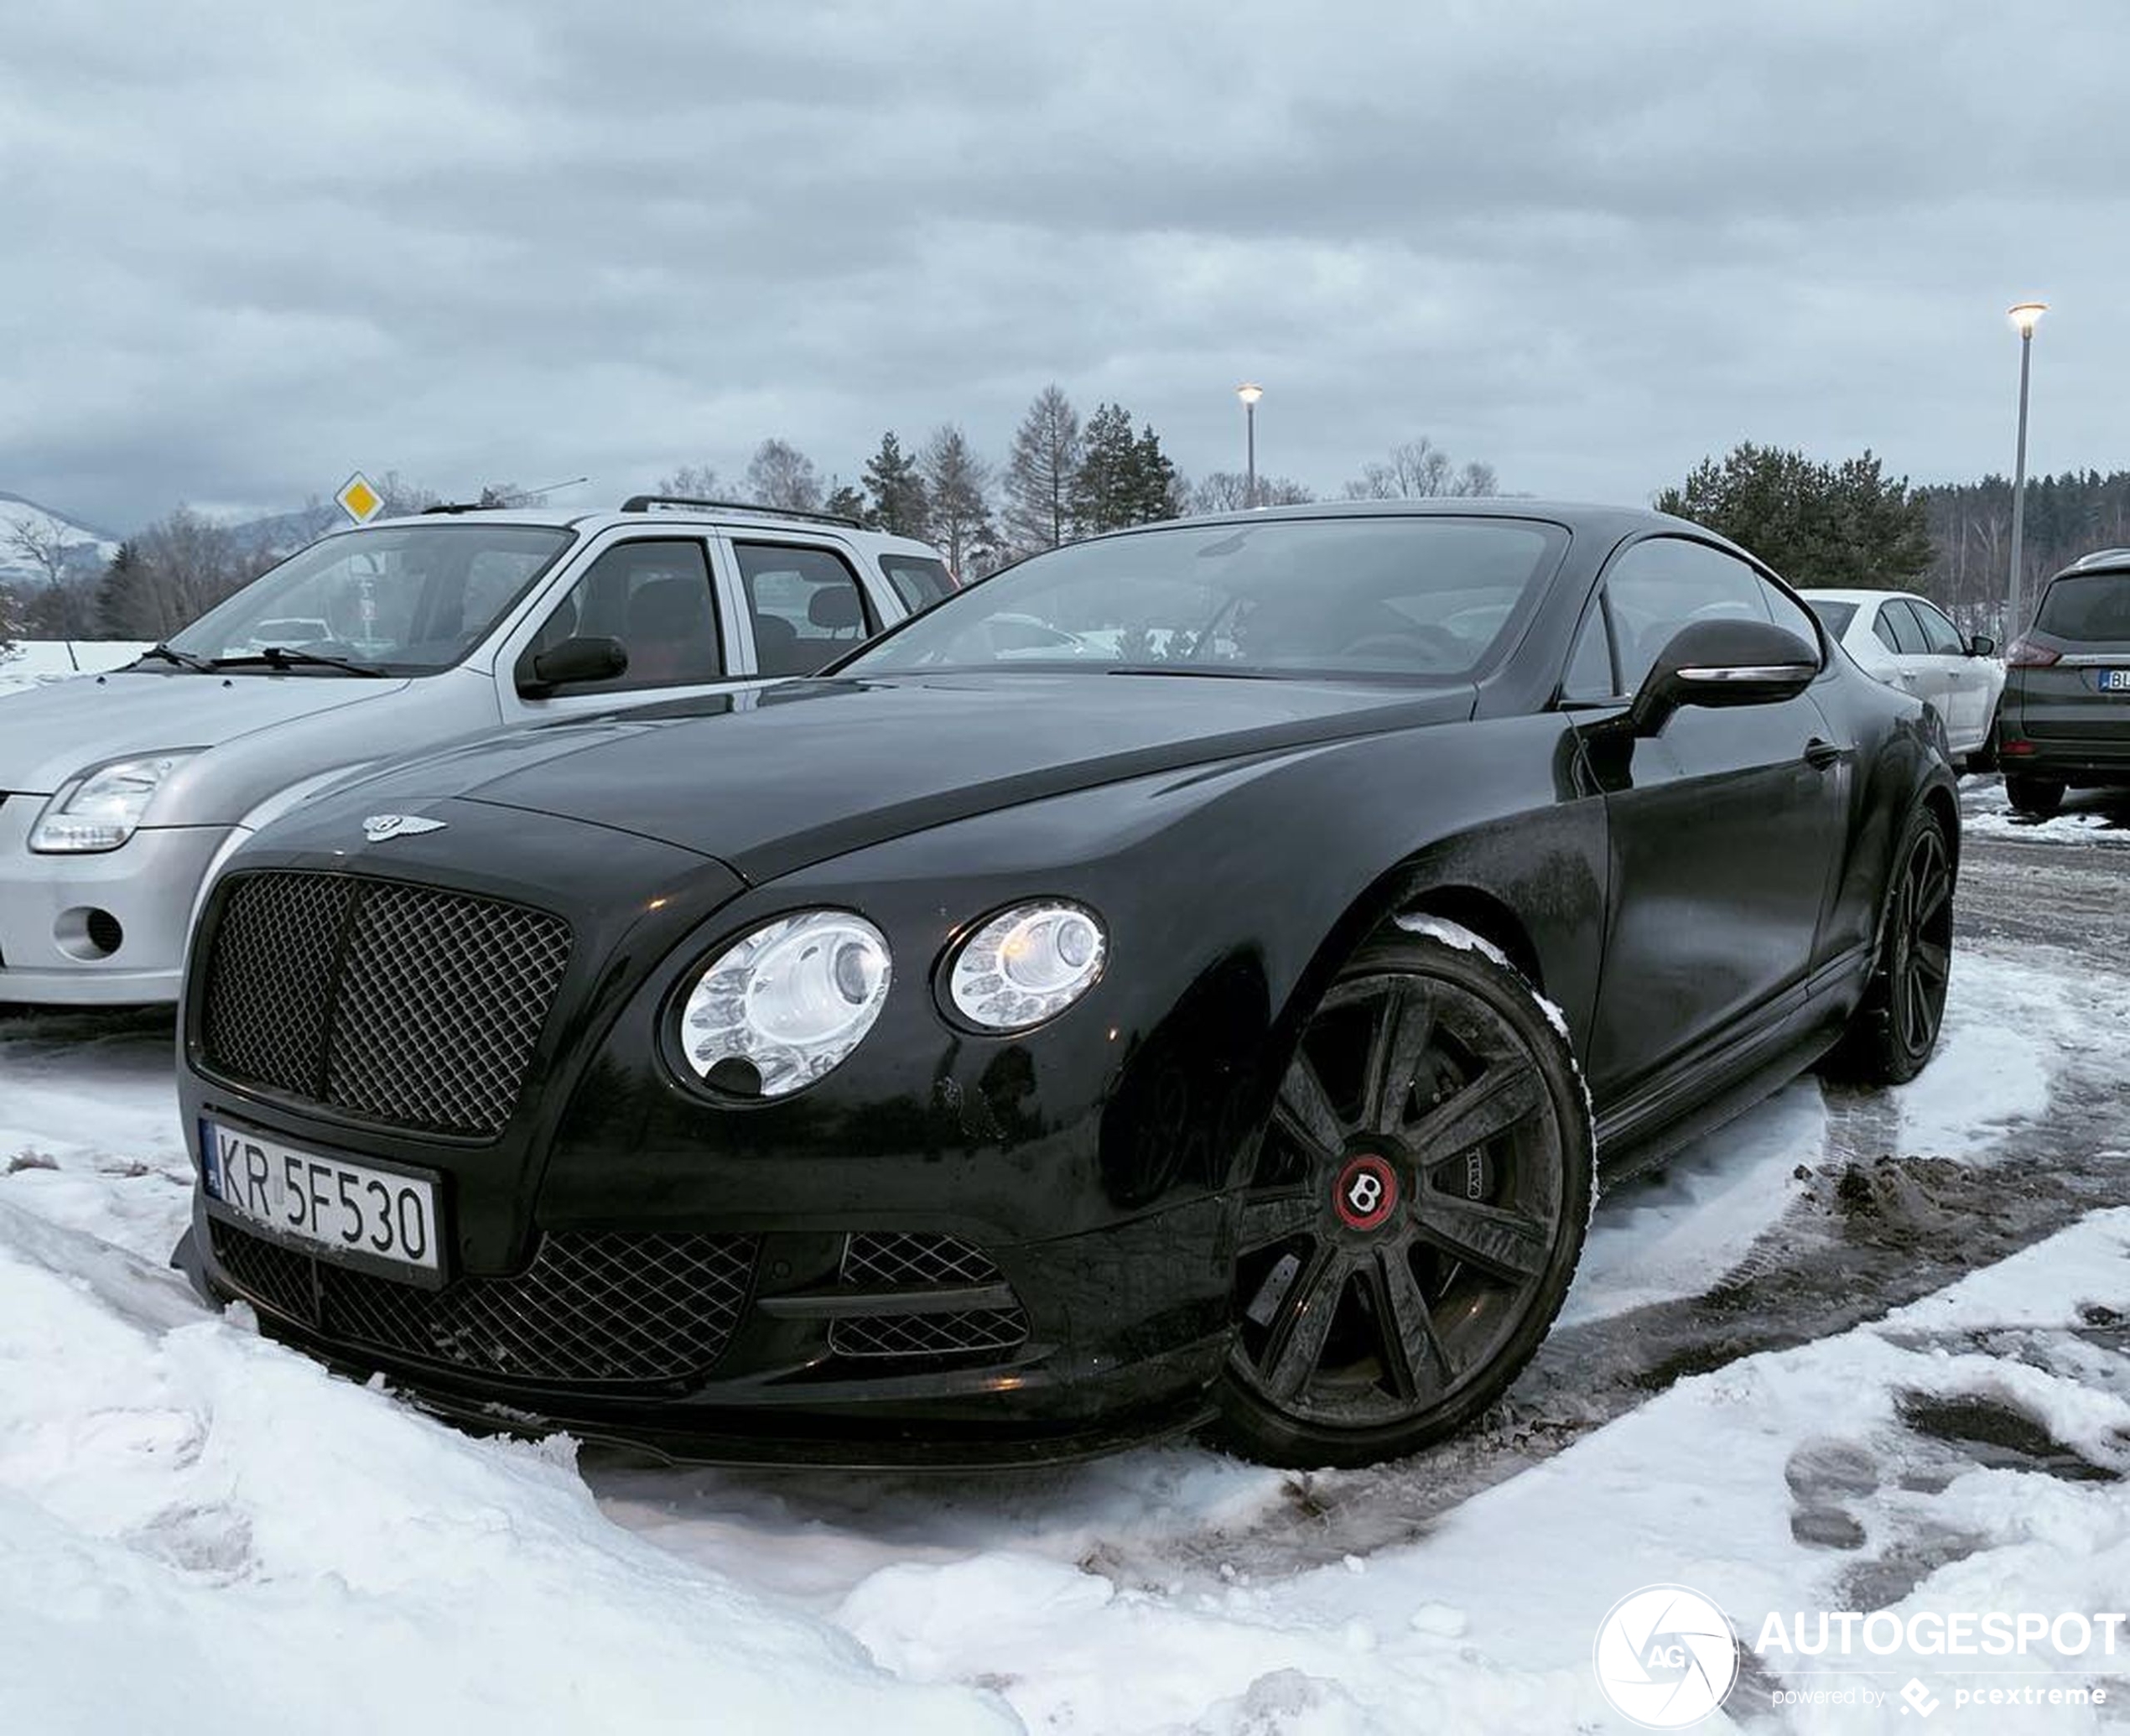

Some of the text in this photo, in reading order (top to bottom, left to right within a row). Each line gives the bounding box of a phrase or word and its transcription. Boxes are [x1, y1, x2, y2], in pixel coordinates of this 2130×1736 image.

[220, 1134, 426, 1260] KR 5F530
[1348, 1173, 1381, 1213] B
